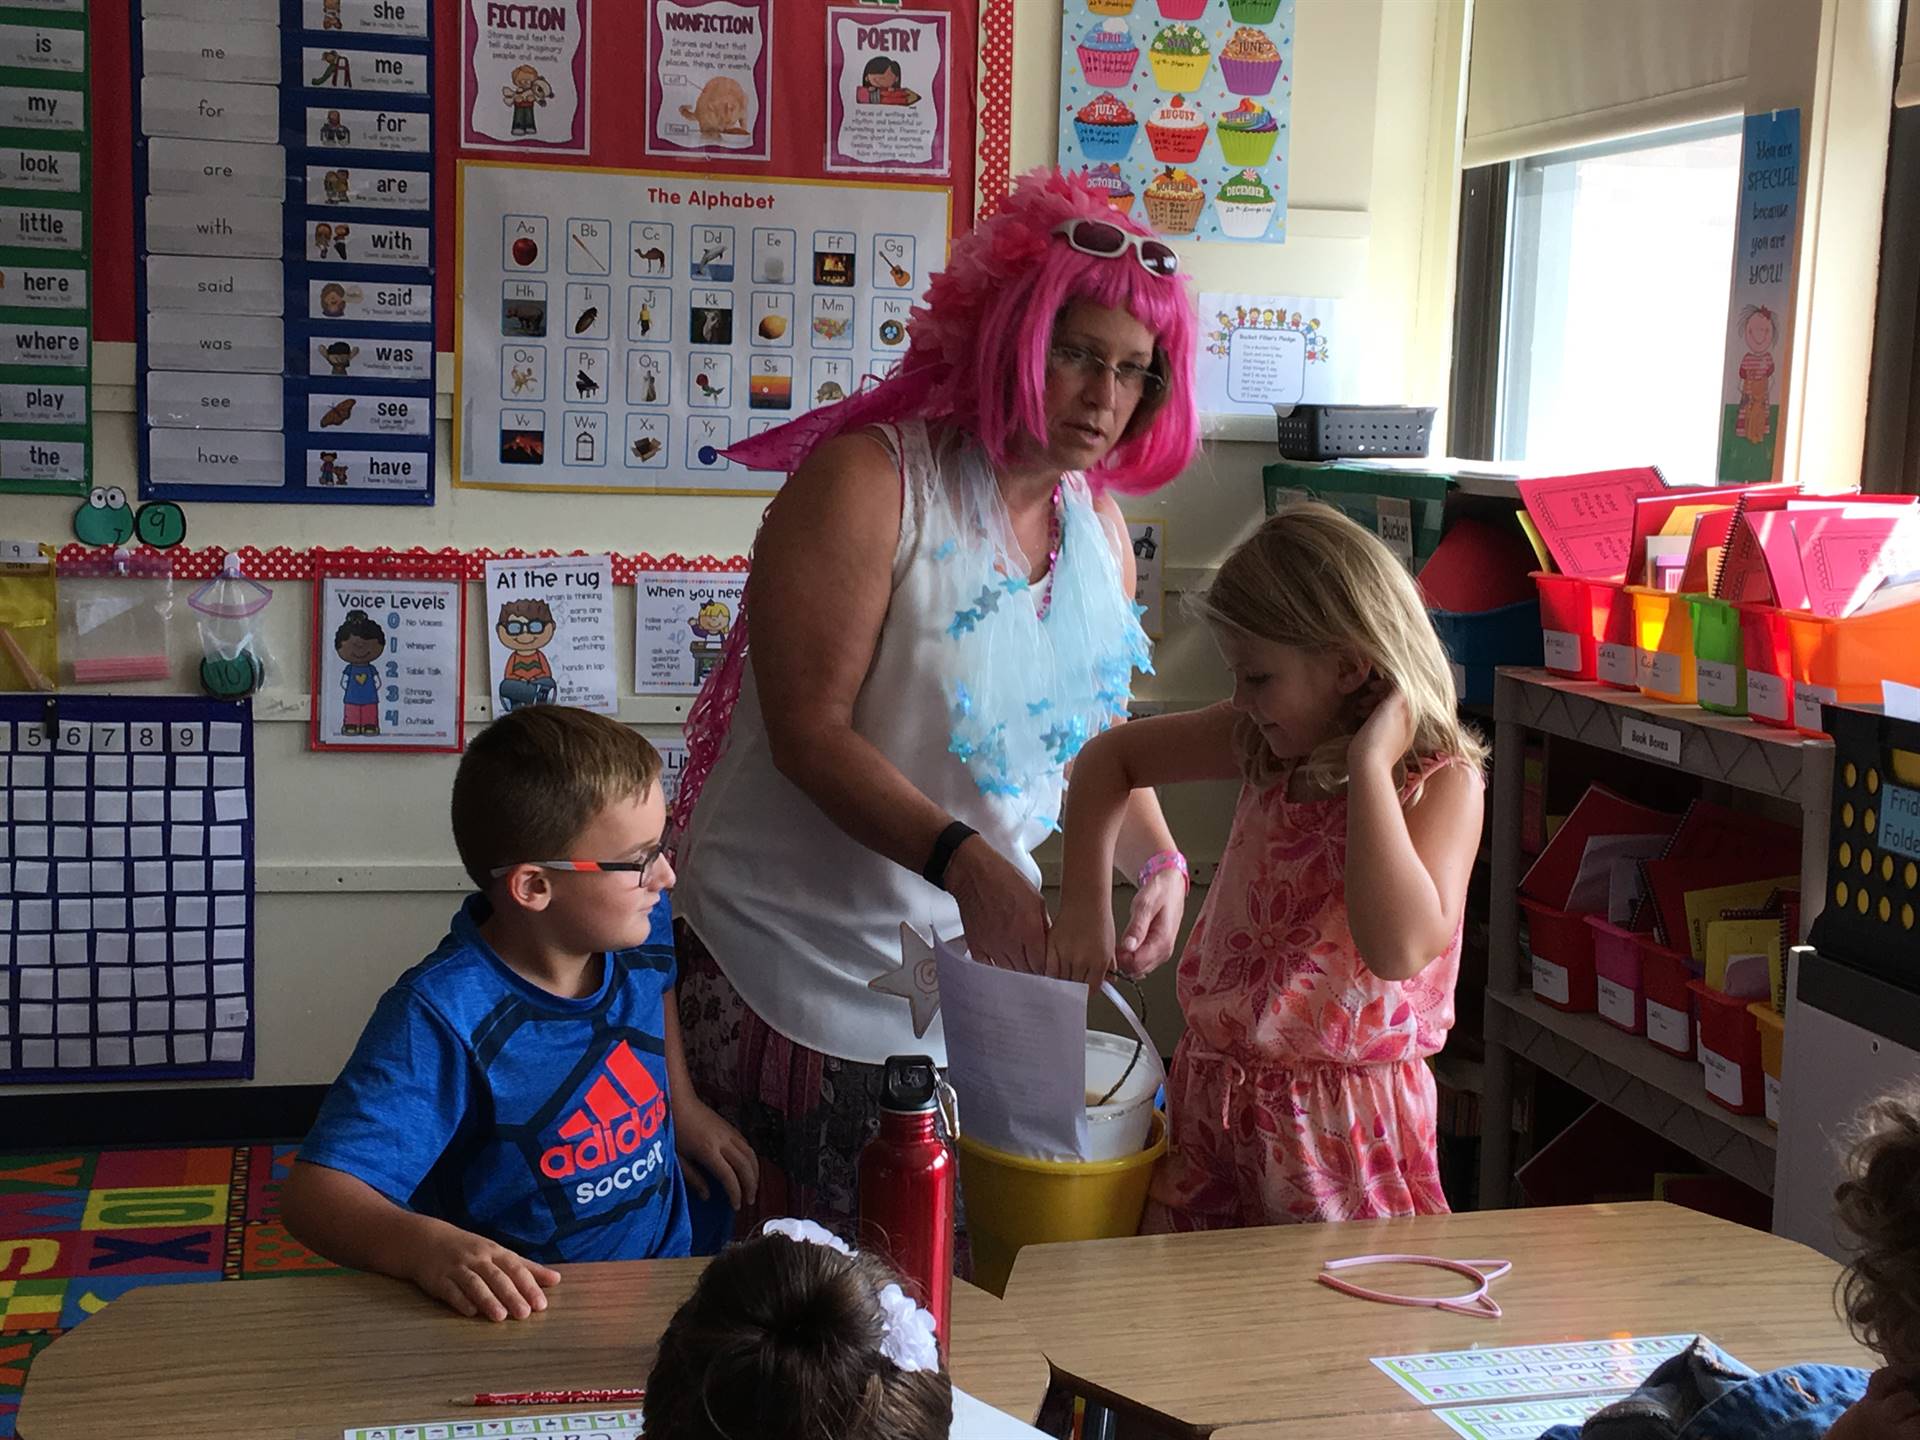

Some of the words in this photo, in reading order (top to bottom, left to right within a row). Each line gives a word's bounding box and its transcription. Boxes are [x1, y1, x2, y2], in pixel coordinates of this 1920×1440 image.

[373, 2, 405, 20] she
[487, 2, 566, 31] FICTION
[665, 12, 754, 34] NONFICTION
[35, 33, 52, 53] is
[857, 27, 921, 53] POETRY
[1239, 40, 1264, 54] JUNE
[201, 48, 225, 59] me
[375, 58, 403, 75] me
[28, 96, 57, 116] my
[198, 99, 224, 118] for
[1094, 103, 1118, 116] JULY
[377, 113, 406, 132] for
[1160, 109, 1196, 121] AUGUST
[20, 152, 58, 175] look
[203, 165, 233, 177] are
[376, 177, 408, 193] are
[1748, 166, 1797, 190] SPECIAL
[1155, 181, 1194, 193] NOVEMBER
[1226, 186, 1265, 198] DECEMBER
[648, 188, 681, 205] The
[688, 191, 775, 210] Alphabet
[20, 213, 64, 233] little
[196, 218, 233, 235] with
[517, 221, 535, 234] Aa
[581, 224, 598, 237] Bb
[371, 232, 412, 251] with
[642, 227, 660, 241] Cc
[704, 231, 722, 244] Dd
[767, 233, 782, 246] Ee
[828, 237, 844, 249] Ff
[884, 240, 903, 257] Gg
[23, 272, 69, 293] here
[198, 277, 233, 293] said
[377, 288, 412, 307] said
[516, 285, 534, 297] Hh
[584, 287, 592, 300] Ii
[644, 290, 656, 308] Jj
[705, 293, 718, 305] Kk
[767, 296, 778, 308] Ll
[822, 299, 844, 311] Mm
[884, 302, 901, 314] Nn
[16, 331, 79, 350] where
[200, 339, 232, 351] was
[376, 347, 413, 362] was
[514, 350, 534, 364] Oo
[580, 353, 595, 369] Pp
[639, 354, 660, 373] Qq
[704, 358, 717, 369] Rr
[764, 360, 778, 373] Ss
[826, 362, 838, 374] Tt
[26, 389, 64, 410] play
[201, 395, 231, 408] see
[377, 401, 408, 417] see
[516, 415, 531, 426] Vv
[574, 417, 597, 430] Ww
[640, 418, 654, 431] Xx
[702, 421, 715, 436] Yy
[30, 446, 60, 465] the
[198, 447, 239, 464] have
[369, 457, 411, 475] have
[149, 511, 167, 536] 9
[12, 545, 20, 557] 9
[497, 572, 516, 589] At
[525, 571, 558, 588] the
[565, 572, 599, 589] rug
[338, 593, 385, 608] Voice
[390, 595, 446, 610] Levels
[647, 586, 684, 598] When
[690, 587, 714, 601] you
[718, 588, 743, 599] nee
[387, 612, 400, 629] 0
[406, 642, 436, 651] Whisper
[386, 661, 398, 678] 2
[386, 685, 399, 702] 3
[385, 710, 399, 726] 4
[28, 728, 41, 746] 5
[67, 727, 81, 745] 6
[102, 728, 116, 746] 7
[140, 728, 153, 746] 8
[180, 728, 193, 746] 9
[1631, 730, 1647, 744] Book
[576, 1140, 663, 1204] soccer
